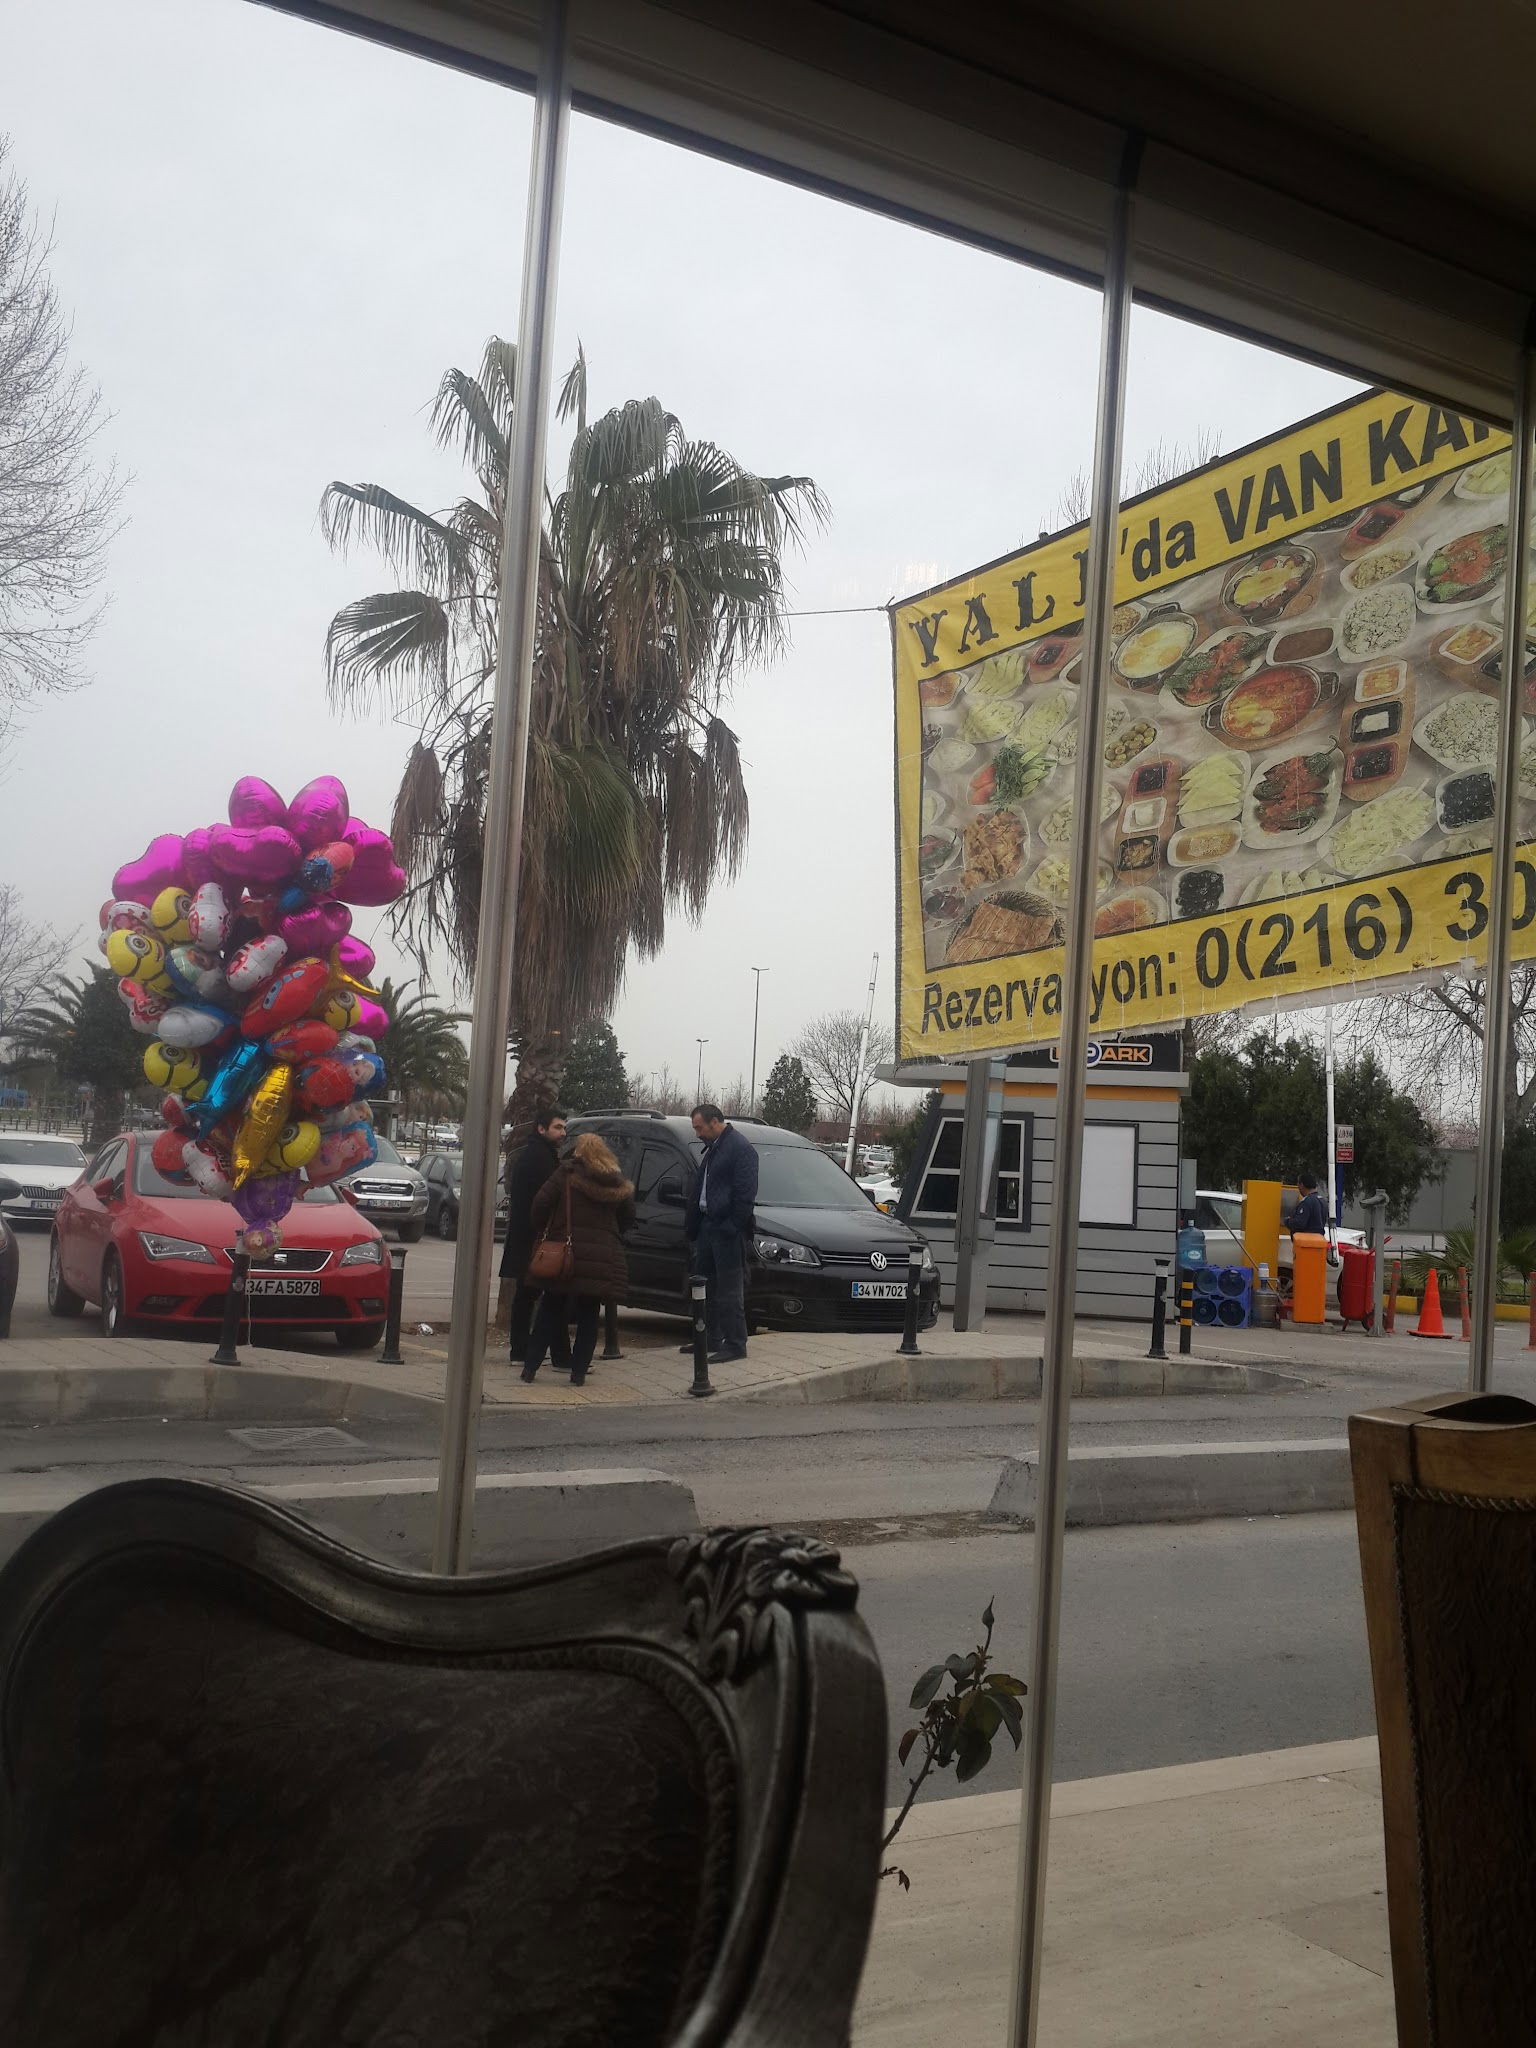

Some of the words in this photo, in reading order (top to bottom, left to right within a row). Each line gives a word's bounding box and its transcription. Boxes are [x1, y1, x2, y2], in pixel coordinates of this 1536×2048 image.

[1213, 438, 1343, 544] VAN
[921, 951, 1177, 1034] Rezervayon:
[1195, 886, 1413, 988] 0(216)
